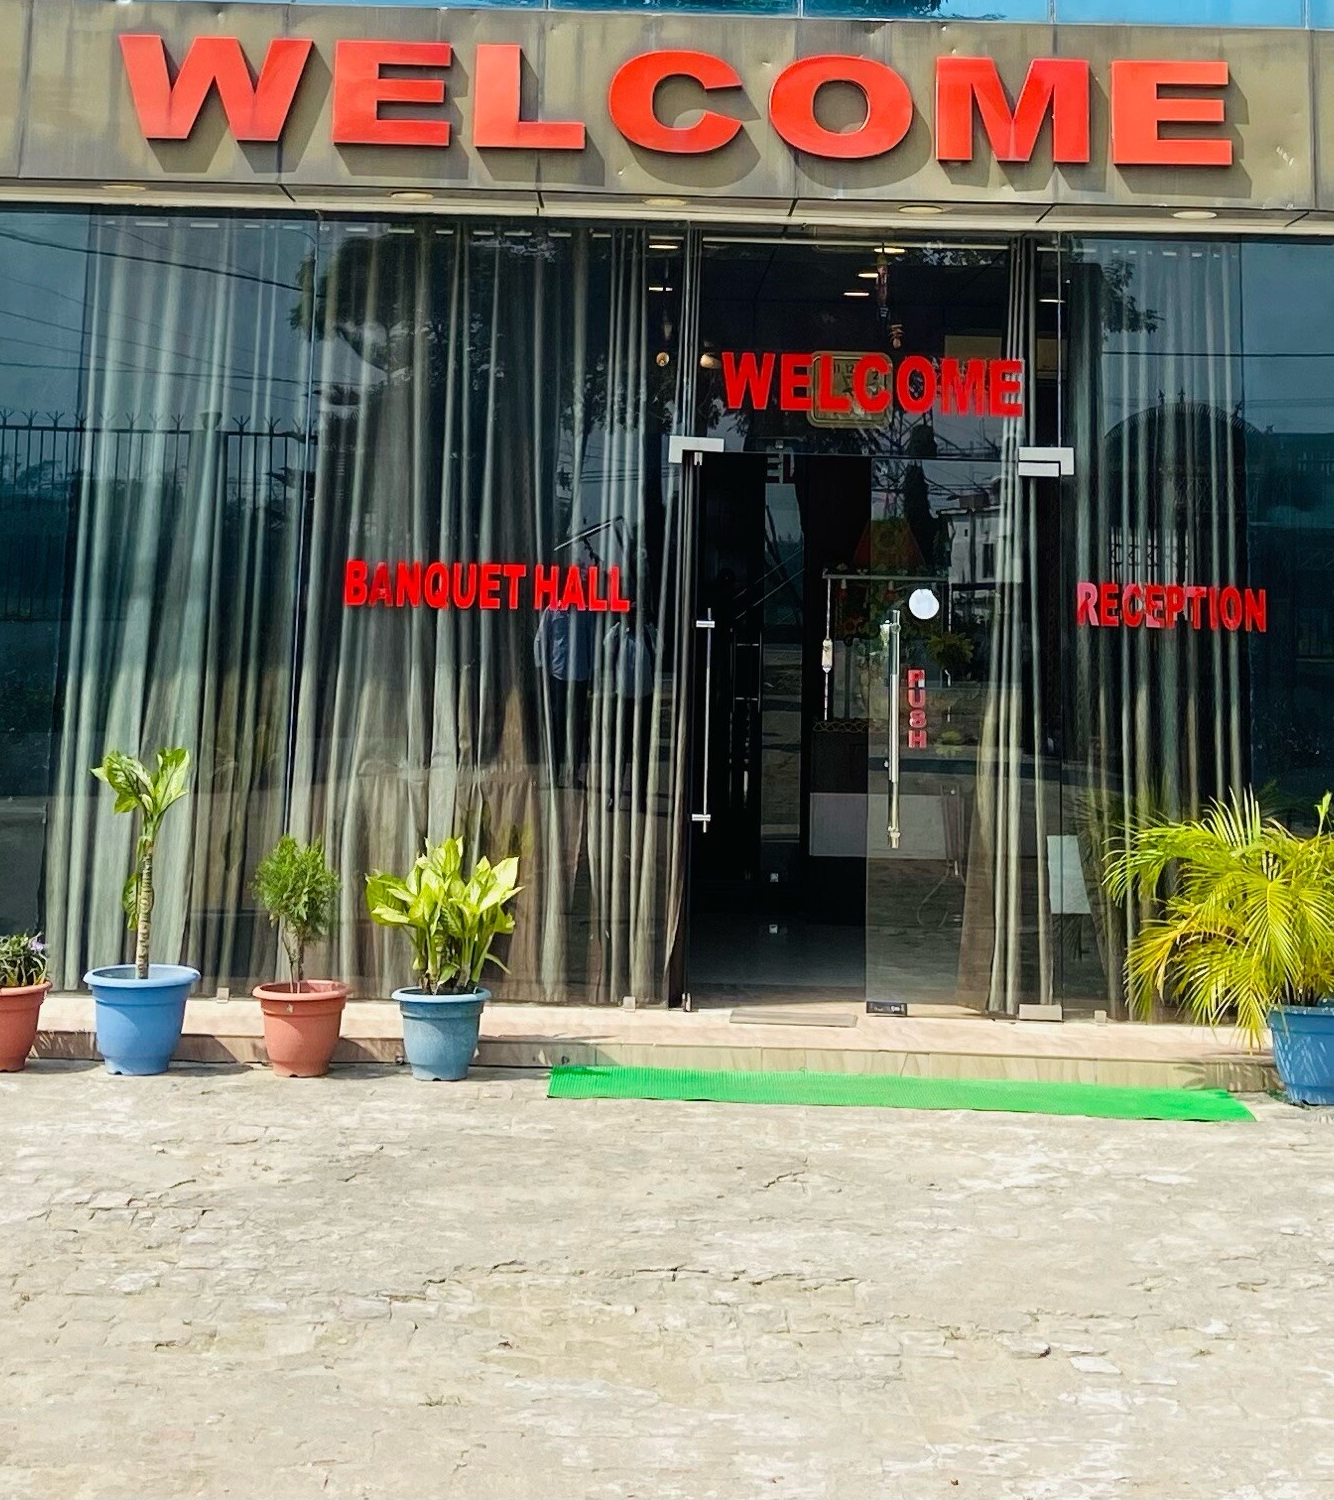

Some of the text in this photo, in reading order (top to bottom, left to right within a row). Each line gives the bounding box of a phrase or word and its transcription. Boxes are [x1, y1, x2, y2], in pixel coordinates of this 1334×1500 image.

[117, 33, 1234, 167] WELCOME
[721, 351, 1025, 418] WELCOME
[344, 558, 631, 613] BANQUET HALL
[1076, 581, 1267, 633] RECEPTION
[907, 669, 927, 749] PUSH
